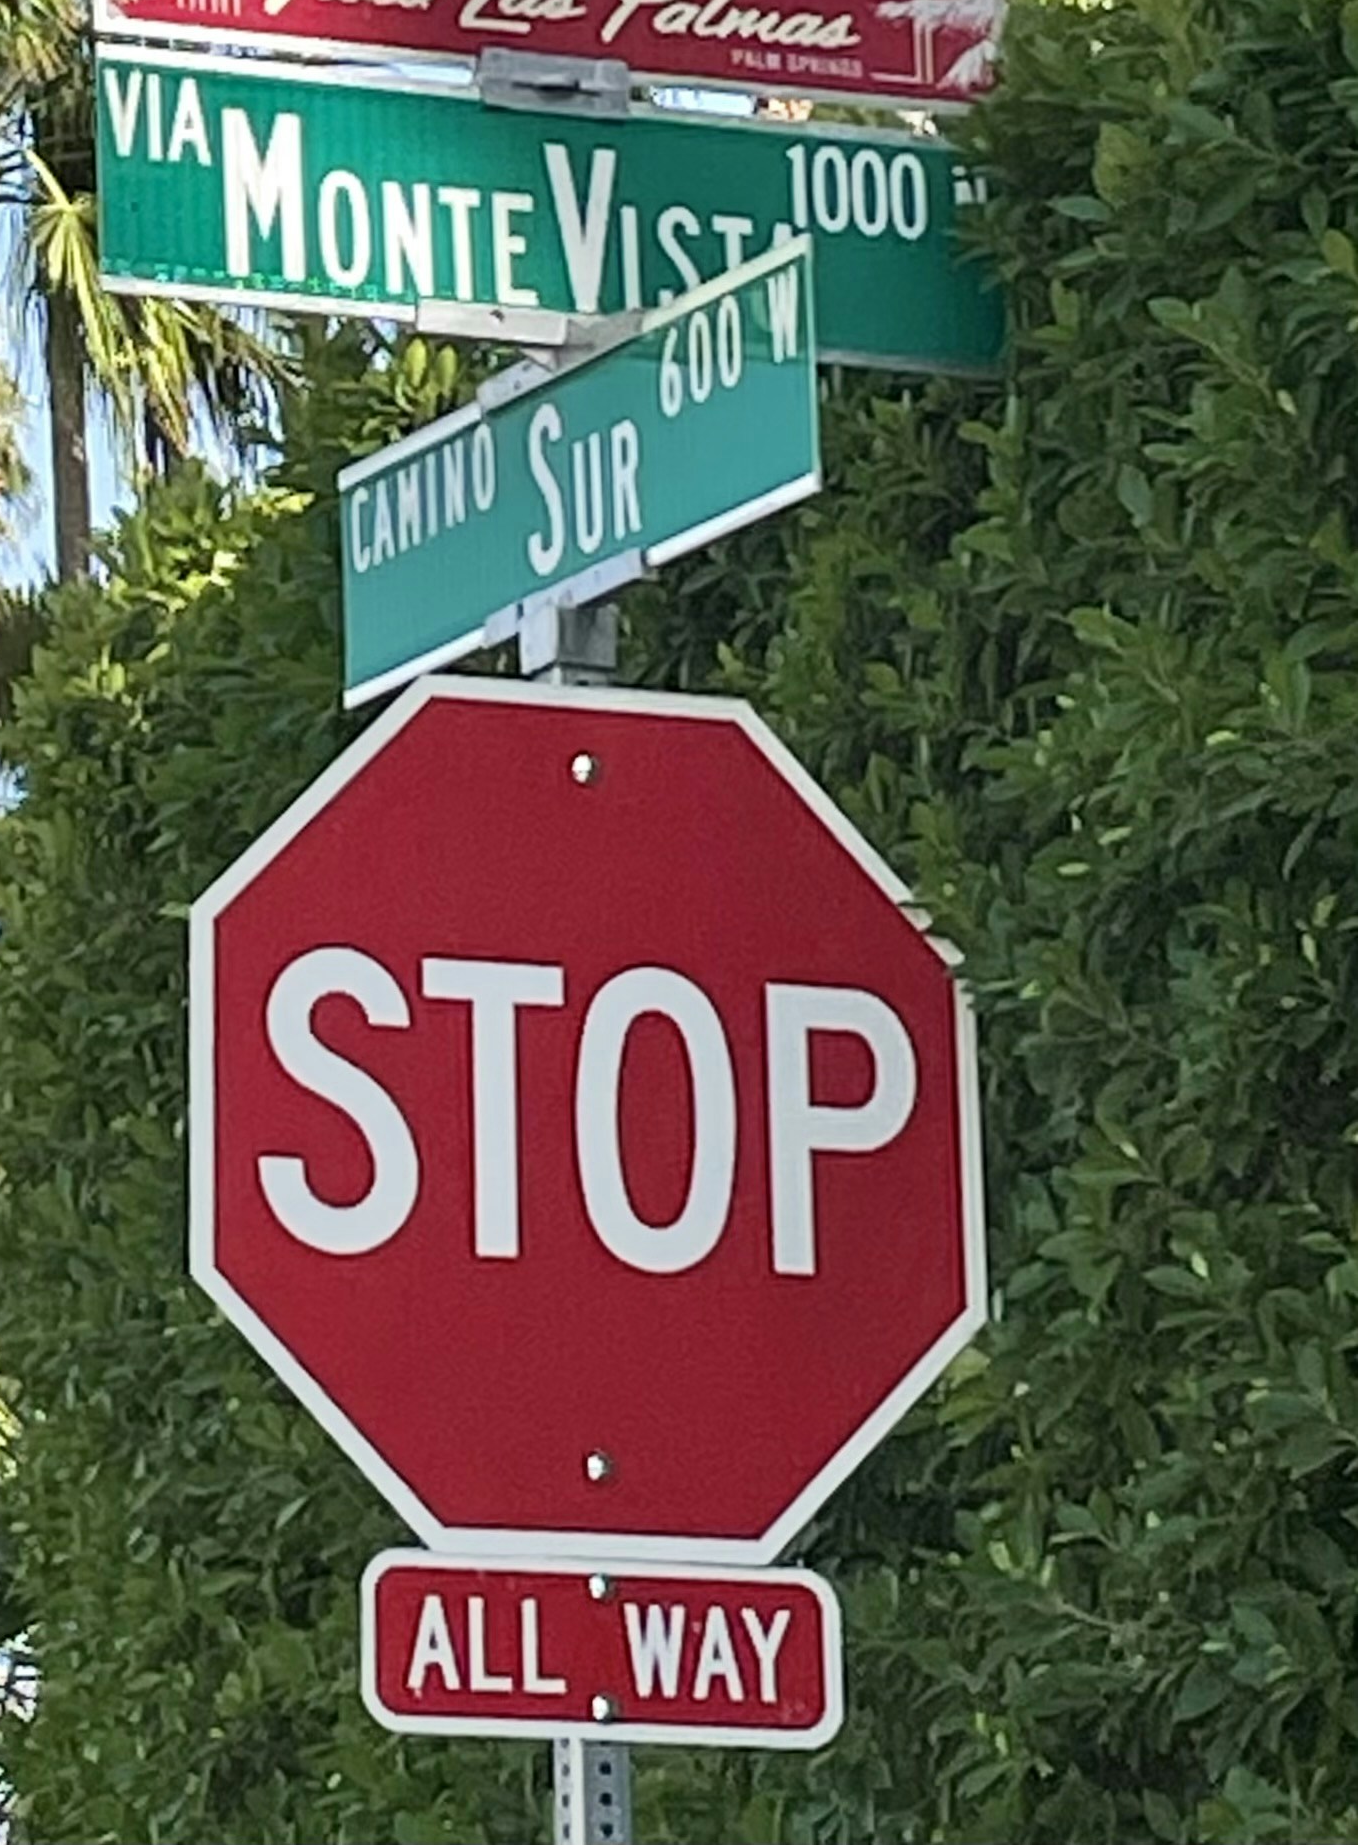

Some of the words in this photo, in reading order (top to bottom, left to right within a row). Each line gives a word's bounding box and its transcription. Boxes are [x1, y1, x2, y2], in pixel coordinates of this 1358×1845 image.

[731, 49, 781, 71] PALM
[104, 68, 210, 166] VIA
[221, 108, 539, 306] MONTE
[786, 143, 928, 240] 1000
[660, 292, 743, 417] 600
[766, 264, 800, 364] W
[350, 422, 497, 574] CAMINO
[527, 402, 643, 578] SUR
[257, 946, 918, 1278] STOP
[406, 1594, 567, 1695] ALL
[622, 1602, 791, 1703] WAY
